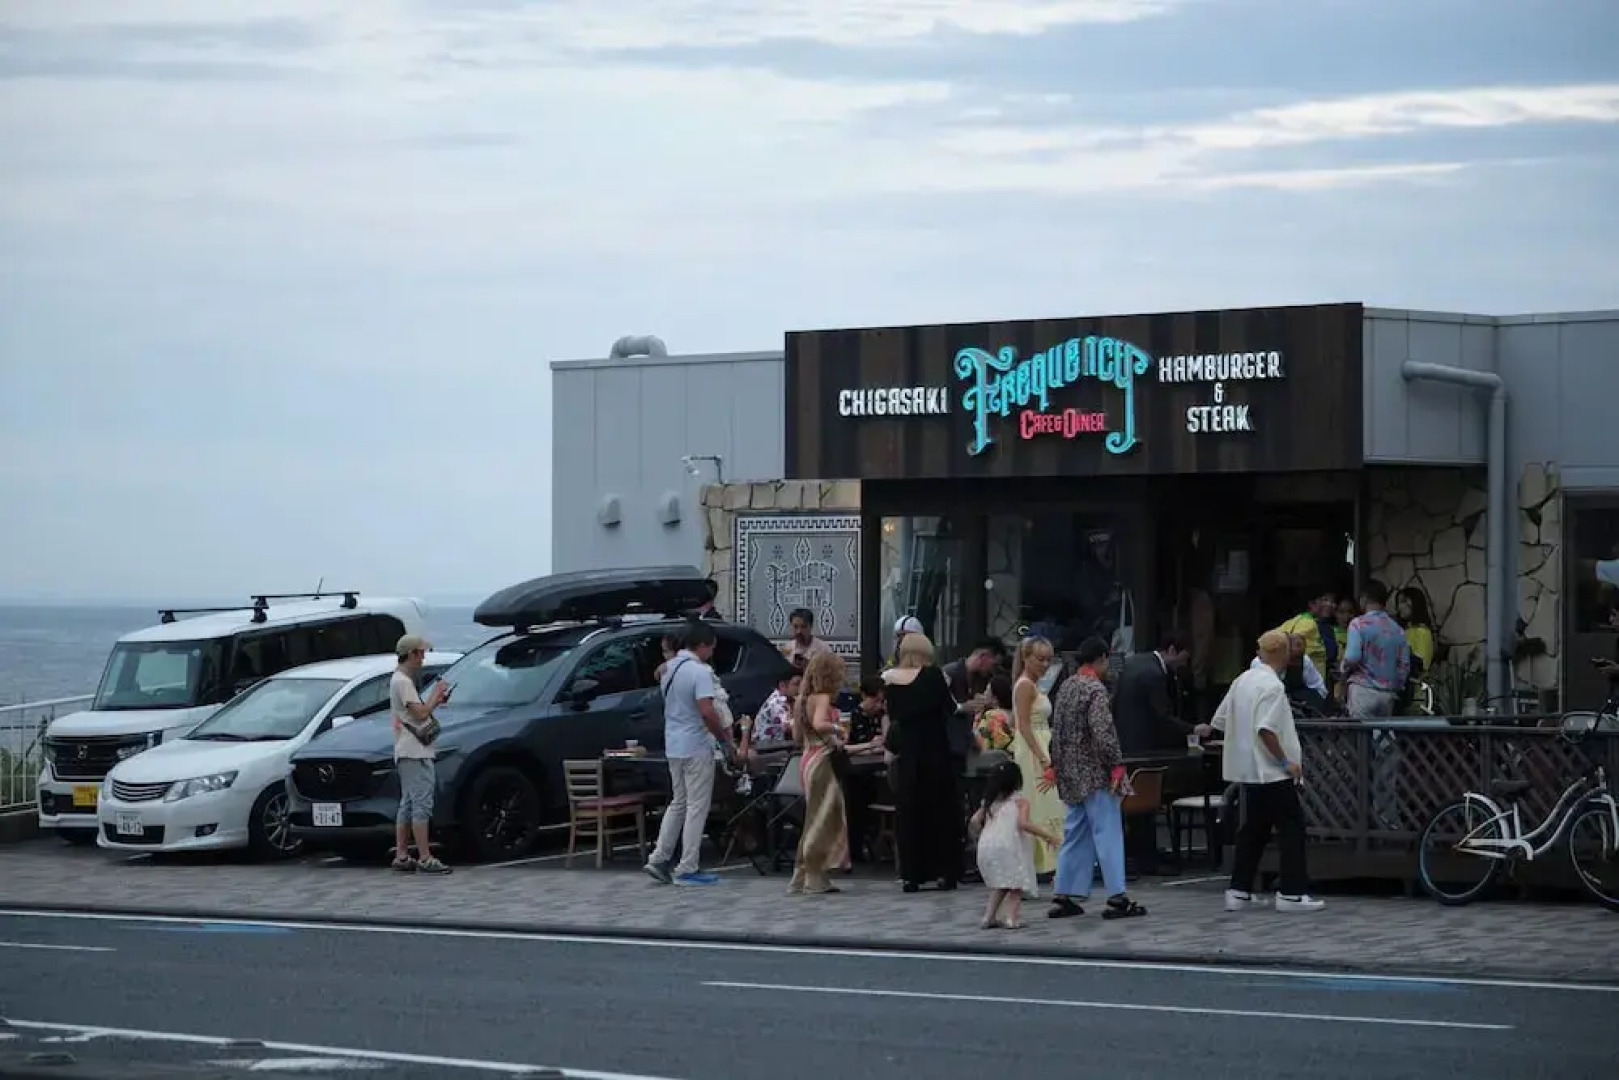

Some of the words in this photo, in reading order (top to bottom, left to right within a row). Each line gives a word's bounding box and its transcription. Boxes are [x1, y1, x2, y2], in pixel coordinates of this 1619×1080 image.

[1158, 350, 1282, 383] HAMBURGER
[839, 386, 948, 417] CHIGASAKI
[1213, 381, 1225, 404] &
[1186, 404, 1252, 434] STEAK
